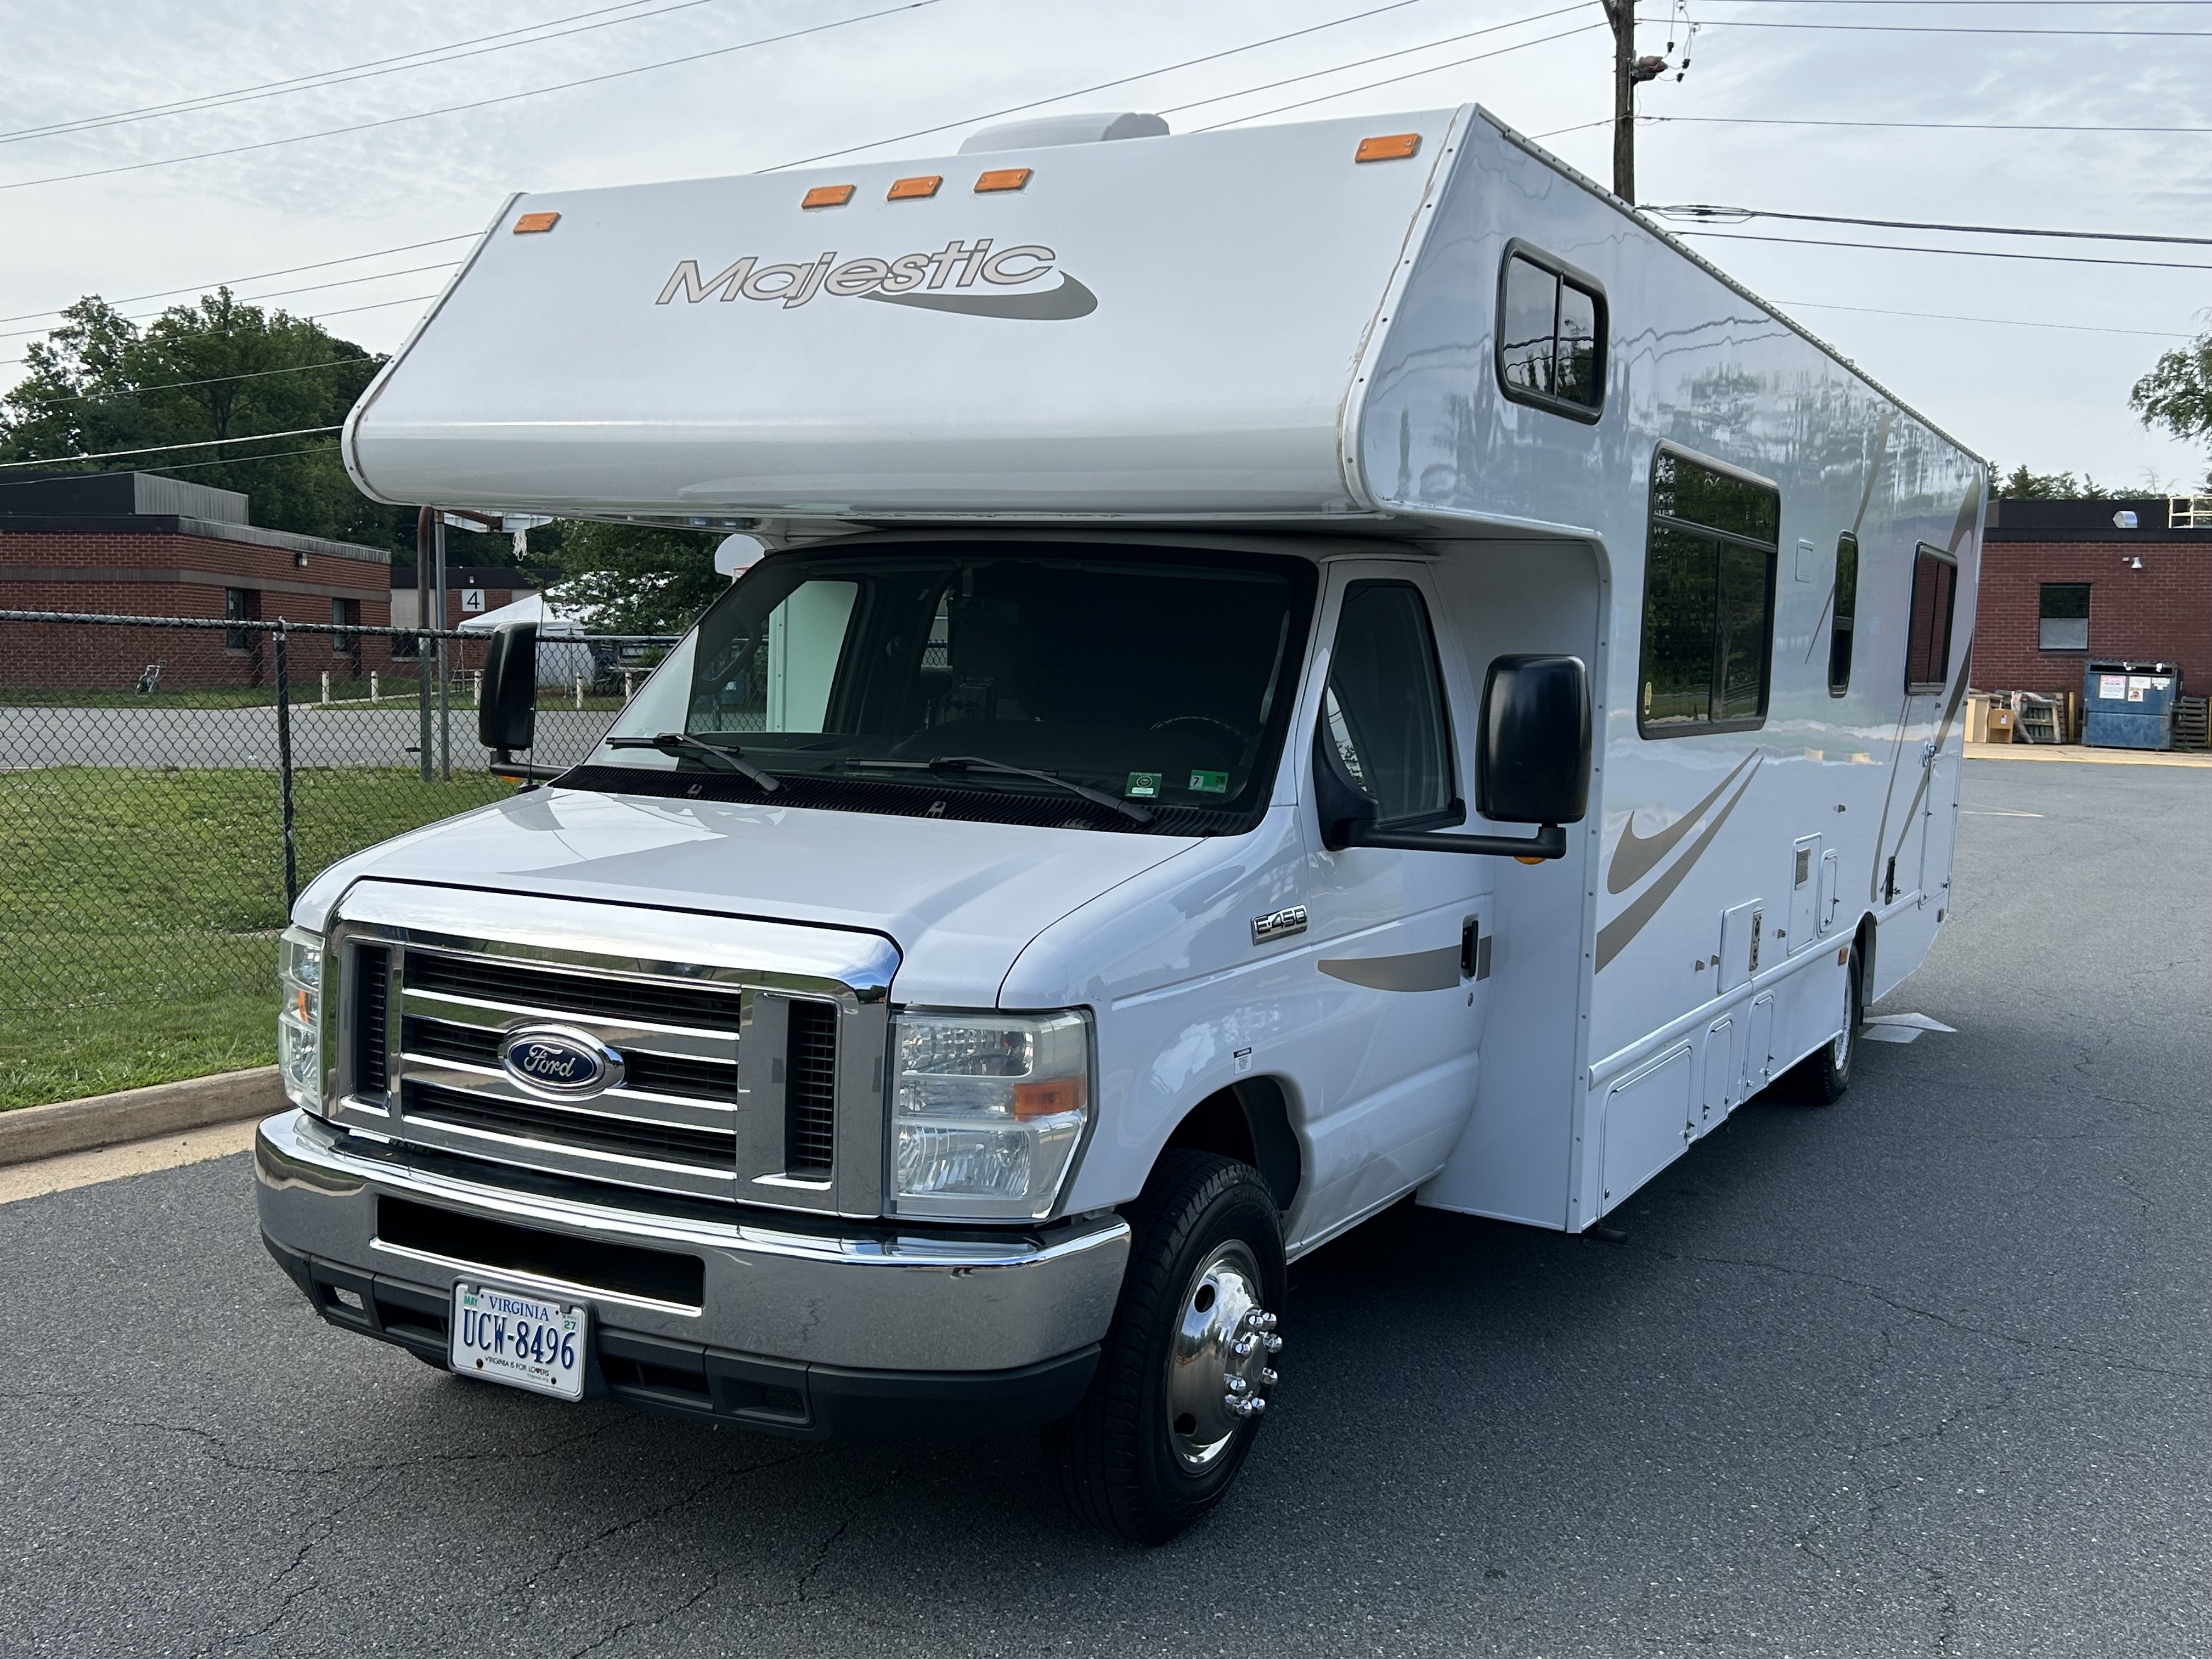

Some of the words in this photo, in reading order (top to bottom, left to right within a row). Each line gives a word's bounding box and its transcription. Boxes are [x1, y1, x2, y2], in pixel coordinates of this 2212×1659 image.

[654, 238, 1057, 309] Majestic
[467, 591, 480, 609] 4
[1194, 777, 1200, 786] 7
[1255, 908, 1307, 934] E-450
[524, 1045, 575, 1077] Ford
[464, 1295, 478, 1307] MAY
[489, 1296, 549, 1322] VIRGINIA
[564, 1320, 577, 1330] 27
[463, 1307, 576, 1370] UCW-8496
[484, 1355, 509, 1367] VIRGINIA
[516, 1362, 527, 1371] FOR
